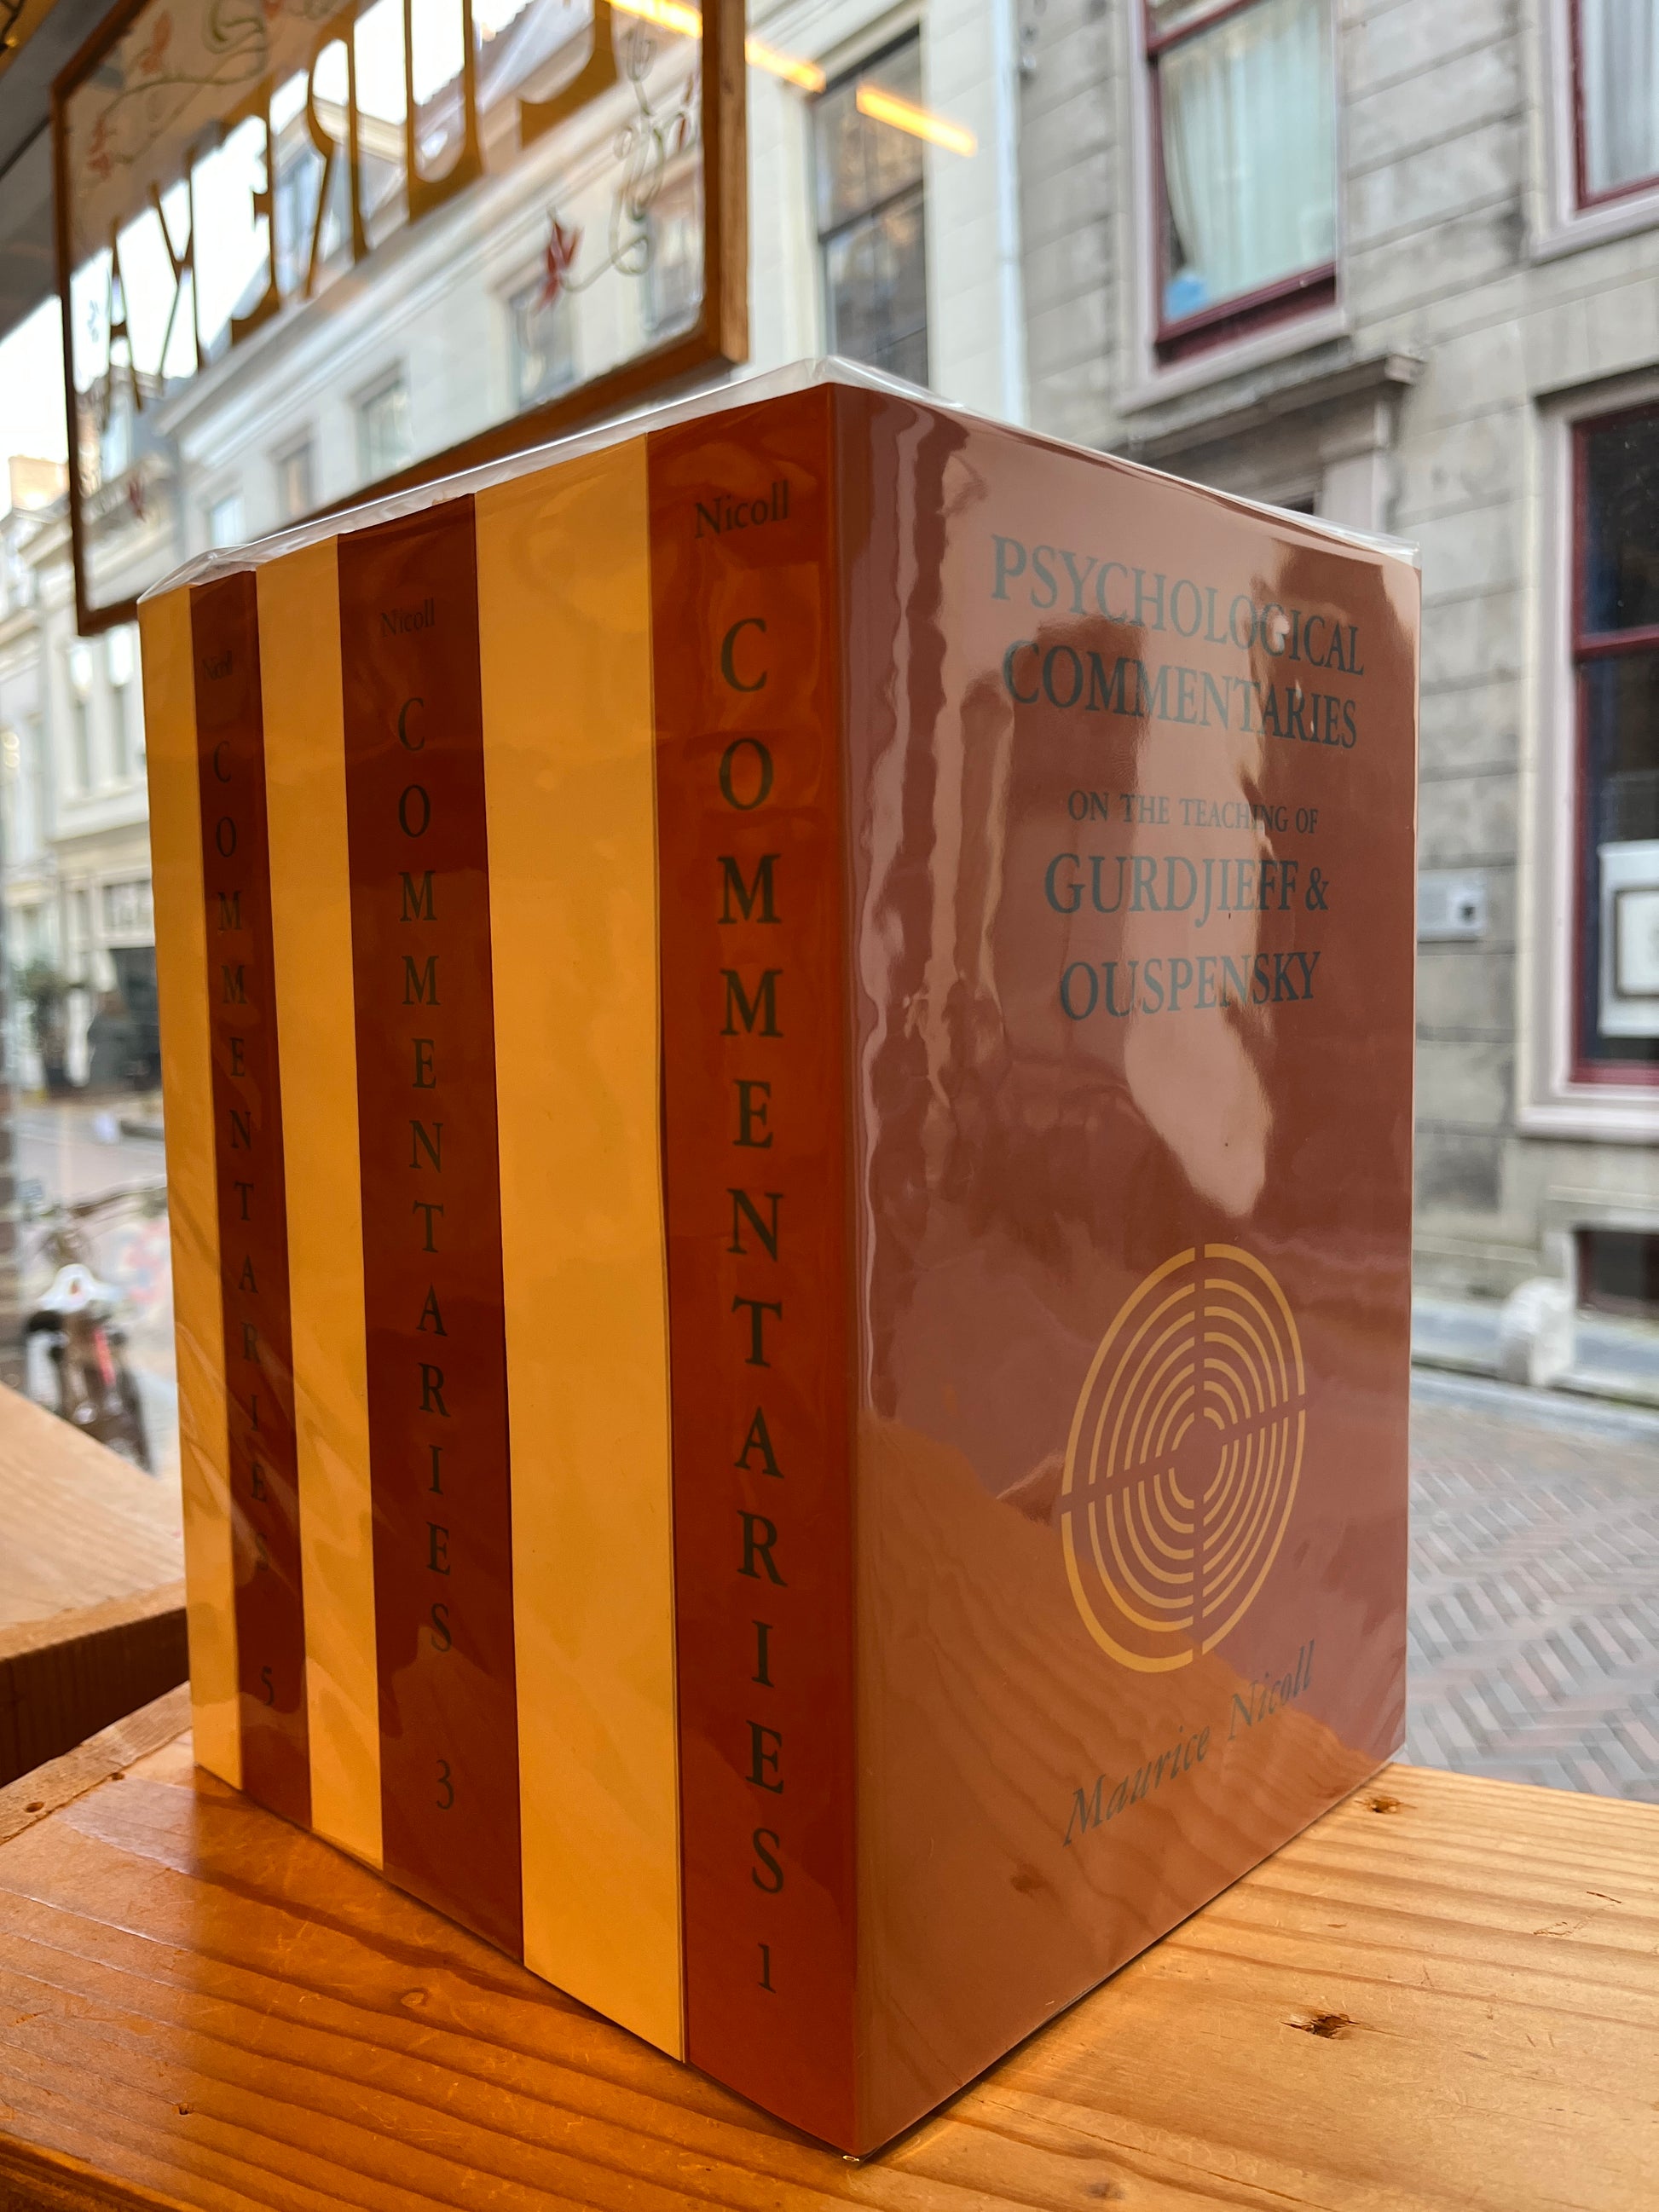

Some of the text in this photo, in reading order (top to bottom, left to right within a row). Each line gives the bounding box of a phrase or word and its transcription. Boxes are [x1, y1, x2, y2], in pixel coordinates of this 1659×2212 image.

[695, 480, 789, 539] Nicoll
[380, 598, 436, 638] Nicoll
[991, 534, 1364, 676] PSYCHOLOGICAL
[1003, 638, 1357, 748] COMMENTARIES
[1067, 789, 1318, 835] ON THE TEACHING OF
[1043, 852, 1329, 928] GURDJIEFF &
[1061, 950, 1322, 1022] OUSPENSKY
[397, 697, 454, 1811] COMMENTARIES 3
[718, 617, 789, 1895] COMMENTARIES
[1062, 1638, 1315, 1848] Maurice Nicoll
